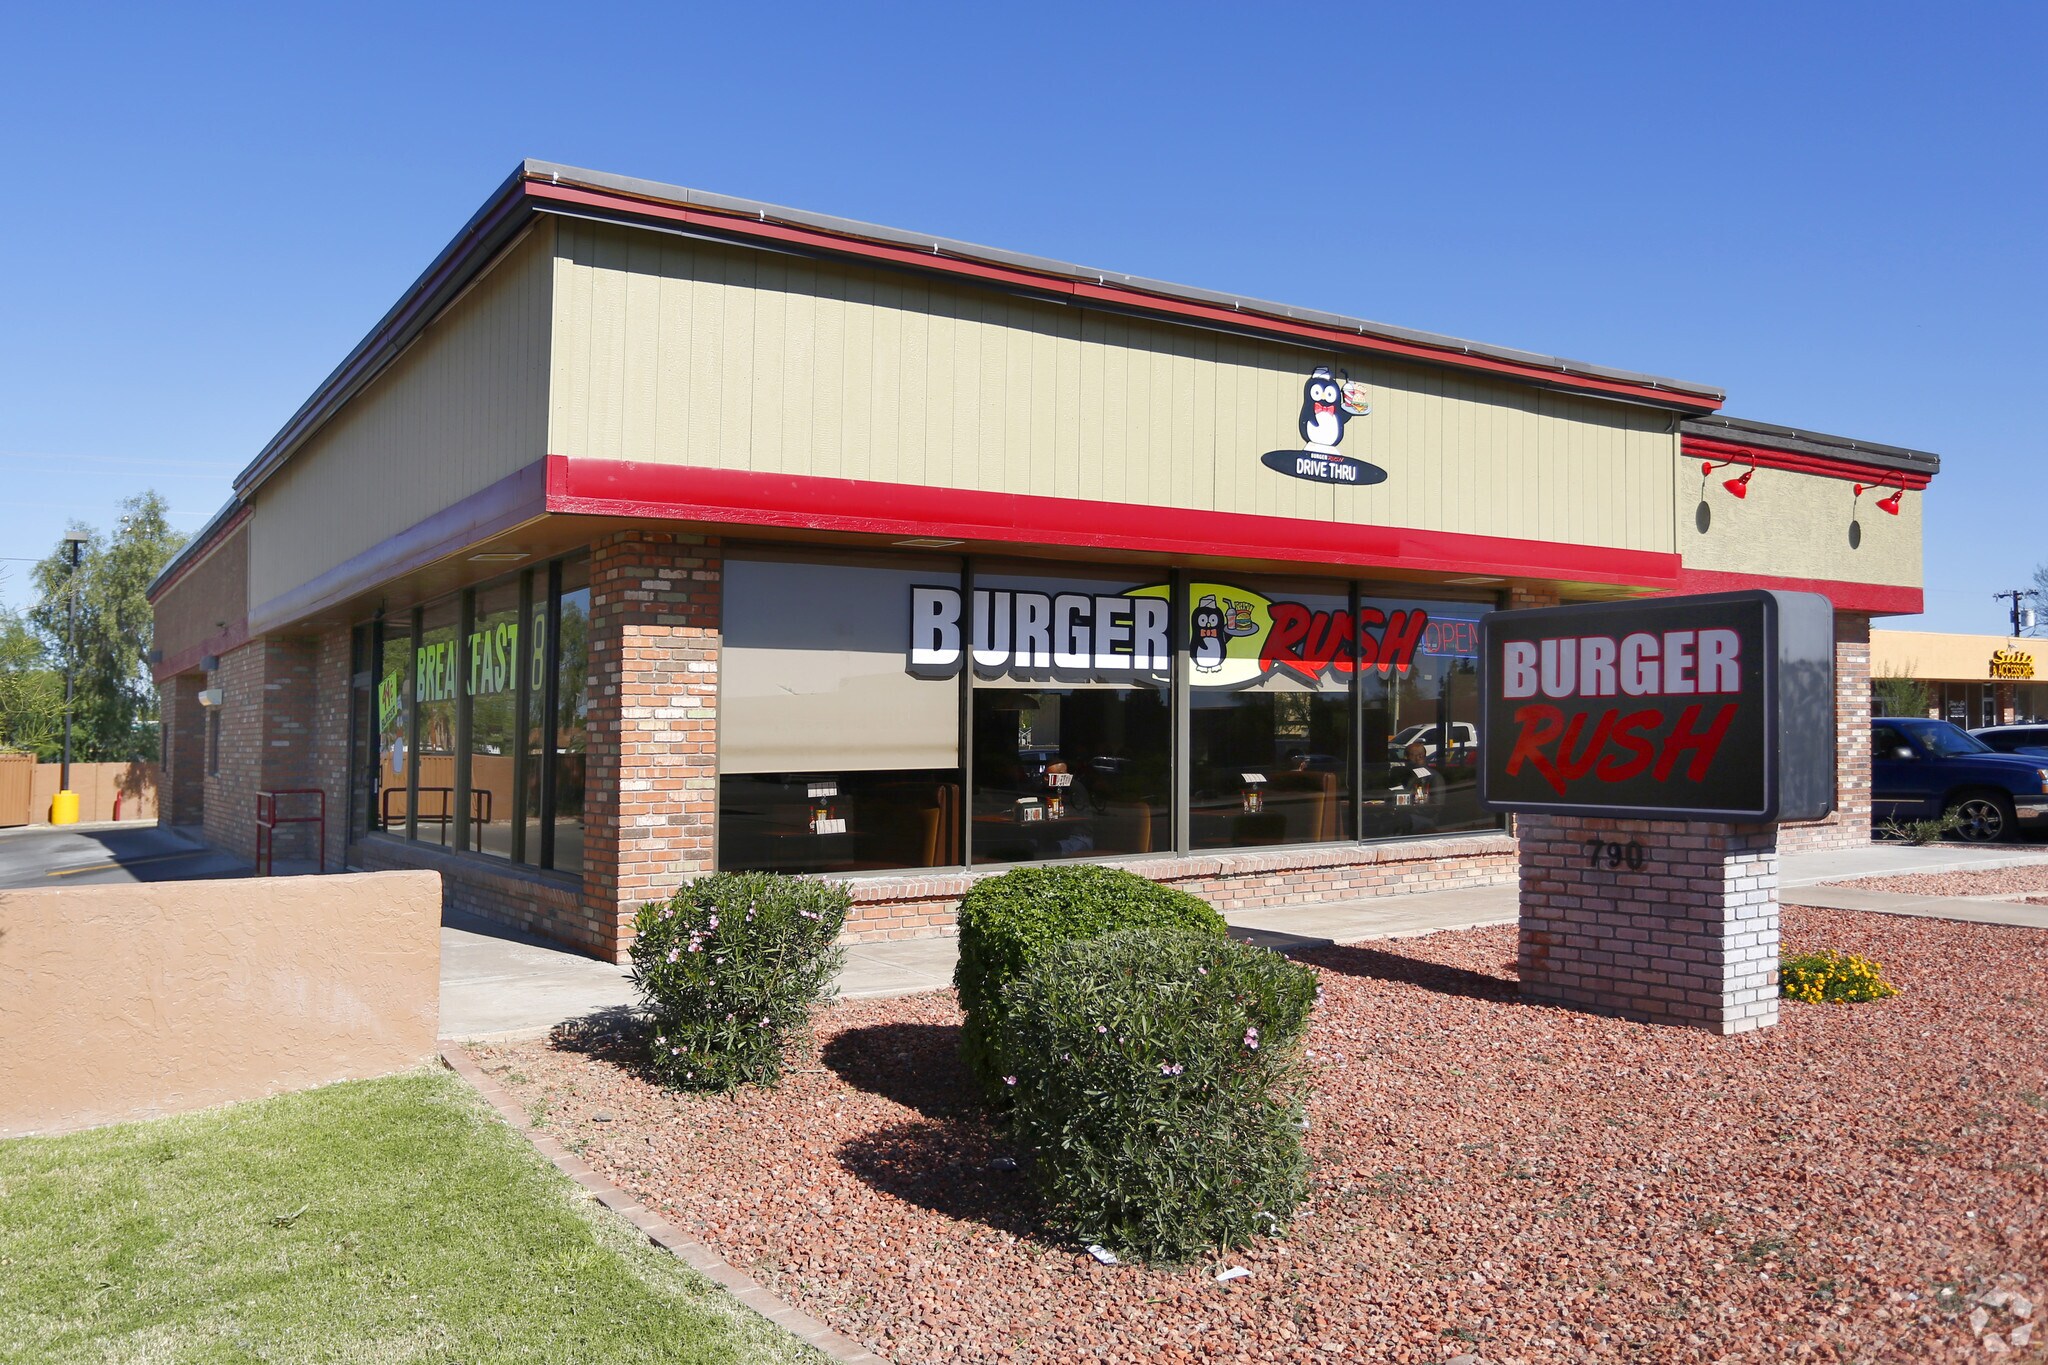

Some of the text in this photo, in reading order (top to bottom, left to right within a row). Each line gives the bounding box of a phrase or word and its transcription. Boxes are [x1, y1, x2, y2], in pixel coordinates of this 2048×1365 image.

[1296, 457, 1356, 482] DRIVE THRU
[908, 584, 1428, 682] BURGER RUSH
[1425, 622, 1479, 653] OPEN
[1503, 628, 1743, 699] BURGER
[1504, 703, 1740, 798] RUSH
[1585, 838, 1643, 871] 790
